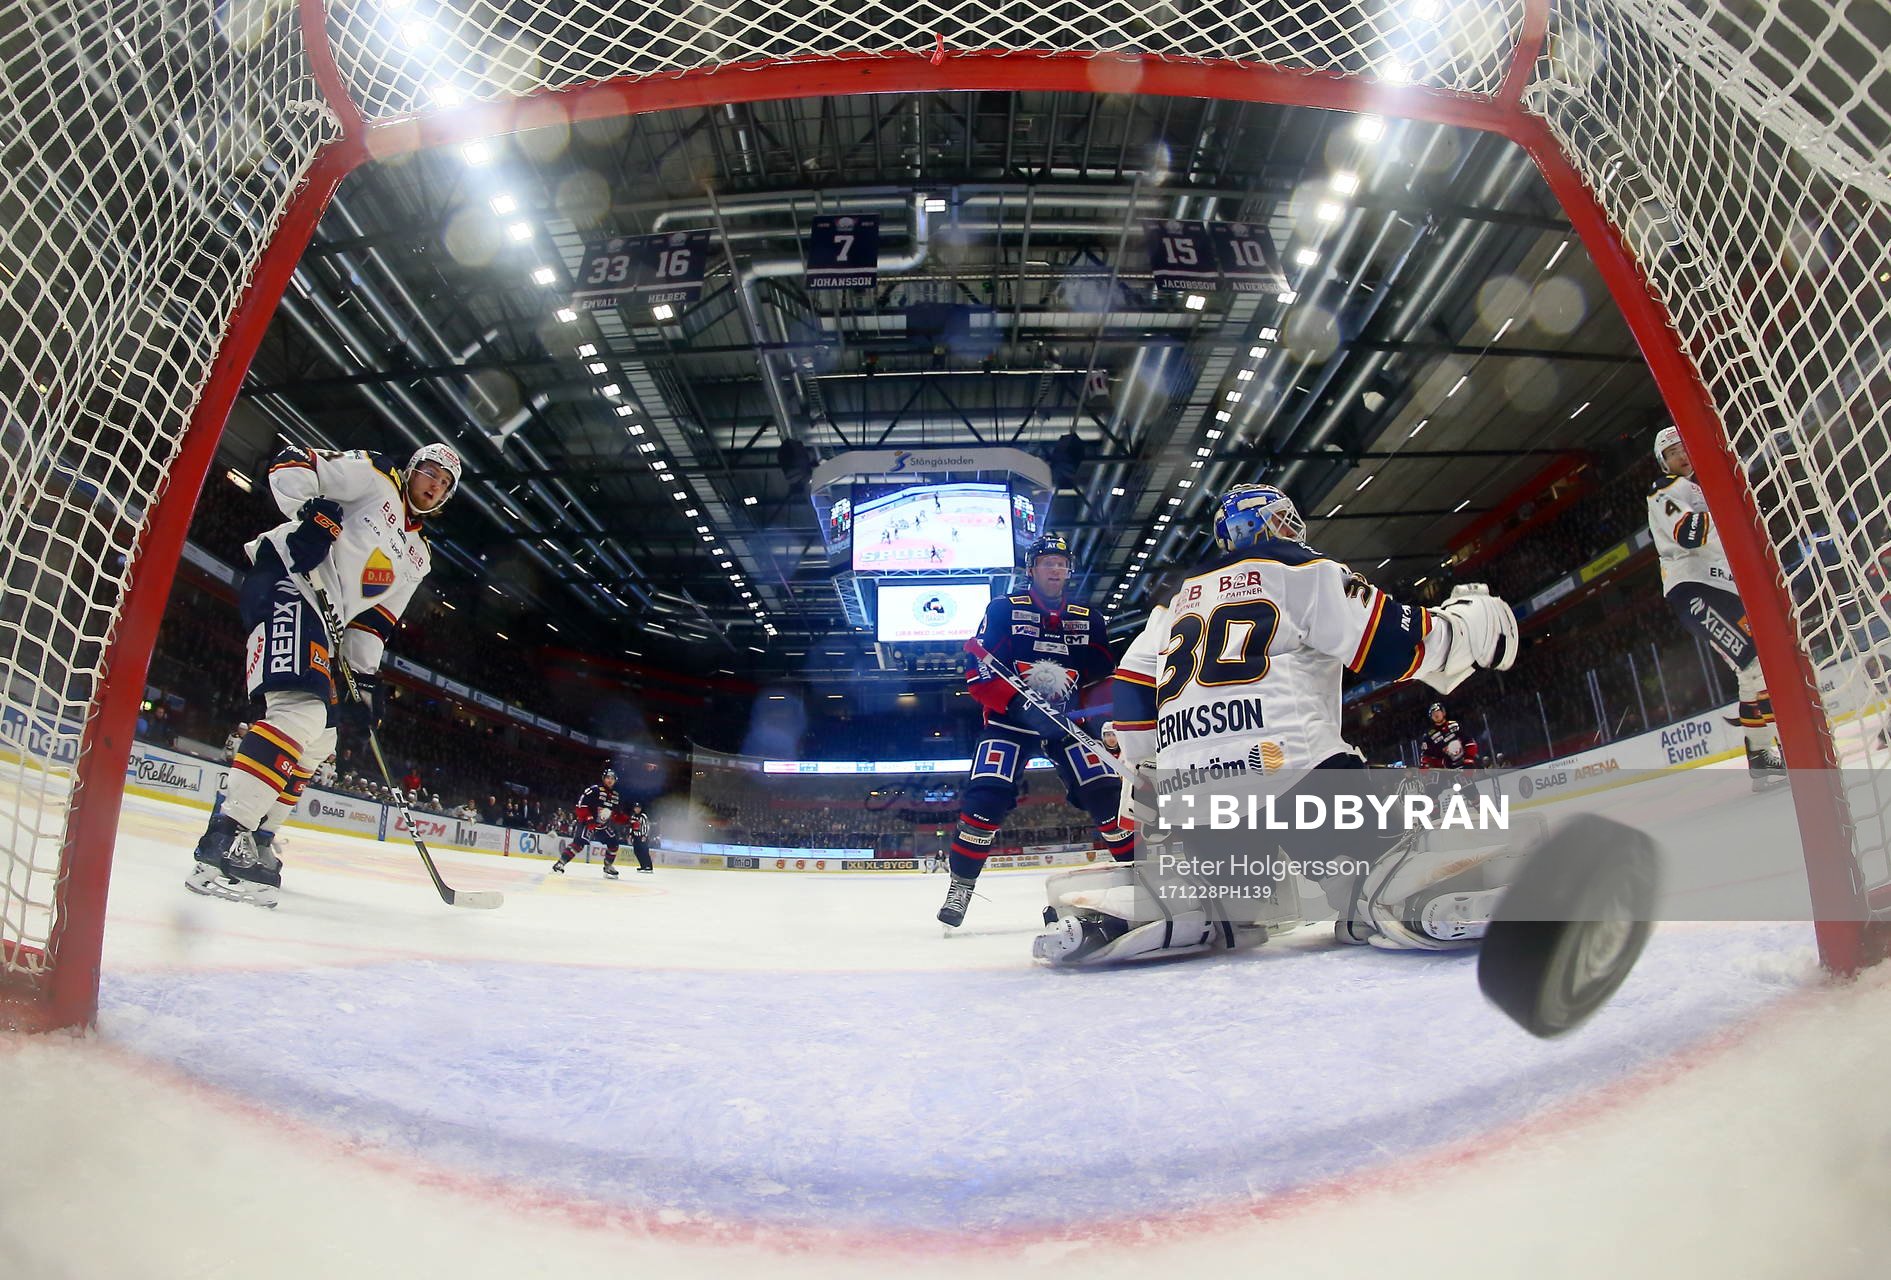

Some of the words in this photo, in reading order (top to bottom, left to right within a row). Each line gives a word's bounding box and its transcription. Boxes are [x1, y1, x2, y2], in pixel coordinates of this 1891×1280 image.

[834, 234, 854, 262] 7
[1162, 237, 1198, 265] 15
[1230, 240, 1267, 267] 10
[588, 255, 630, 284] 33
[656, 249, 691, 278] 16
[810, 277, 872, 287] JOHANSSON
[1162, 279, 1216, 291] JACOBSSON
[648, 292, 687, 303] HELBER
[910, 456, 974, 468] Stångåstaden
[1665, 499, 1682, 517] 4
[1219, 571, 1262, 593] B2B
[270, 601, 294, 673] REFIX
[1701, 608, 1743, 656] REFIX
[1157, 598, 1280, 712] 30
[1661, 720, 1712, 748] ActiPro
[1667, 739, 1710, 764] Event
[138, 760, 188, 788] Reklam
[1535, 772, 1568, 790] SAAB
[1574, 758, 1620, 781] ARENA
[322, 806, 345, 818] SAAB
[349, 811, 376, 823] ARENA
